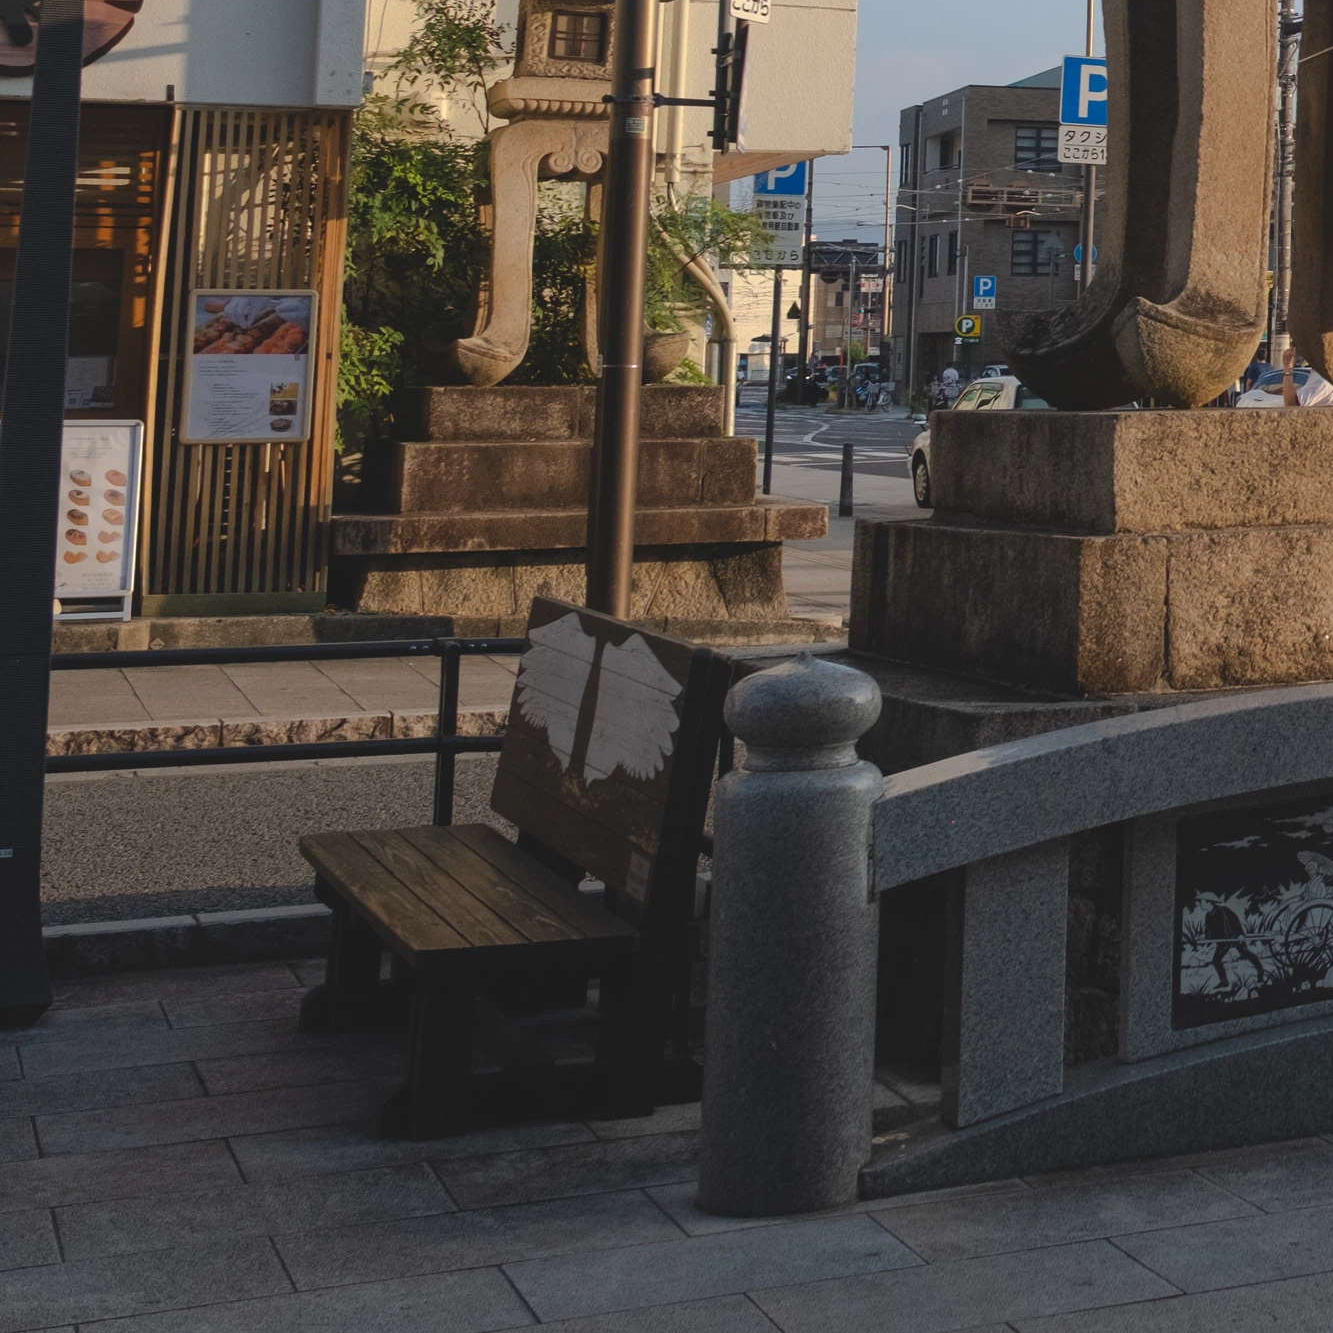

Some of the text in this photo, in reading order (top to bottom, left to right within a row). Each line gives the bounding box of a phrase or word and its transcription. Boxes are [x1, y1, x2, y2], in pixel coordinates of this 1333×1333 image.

[1078, 64, 1107, 118] P
[1063, 147, 1107, 161] ここから1
[767, 163, 798, 190] P
[980, 278, 992, 295] P
[962, 319, 973, 333] P
